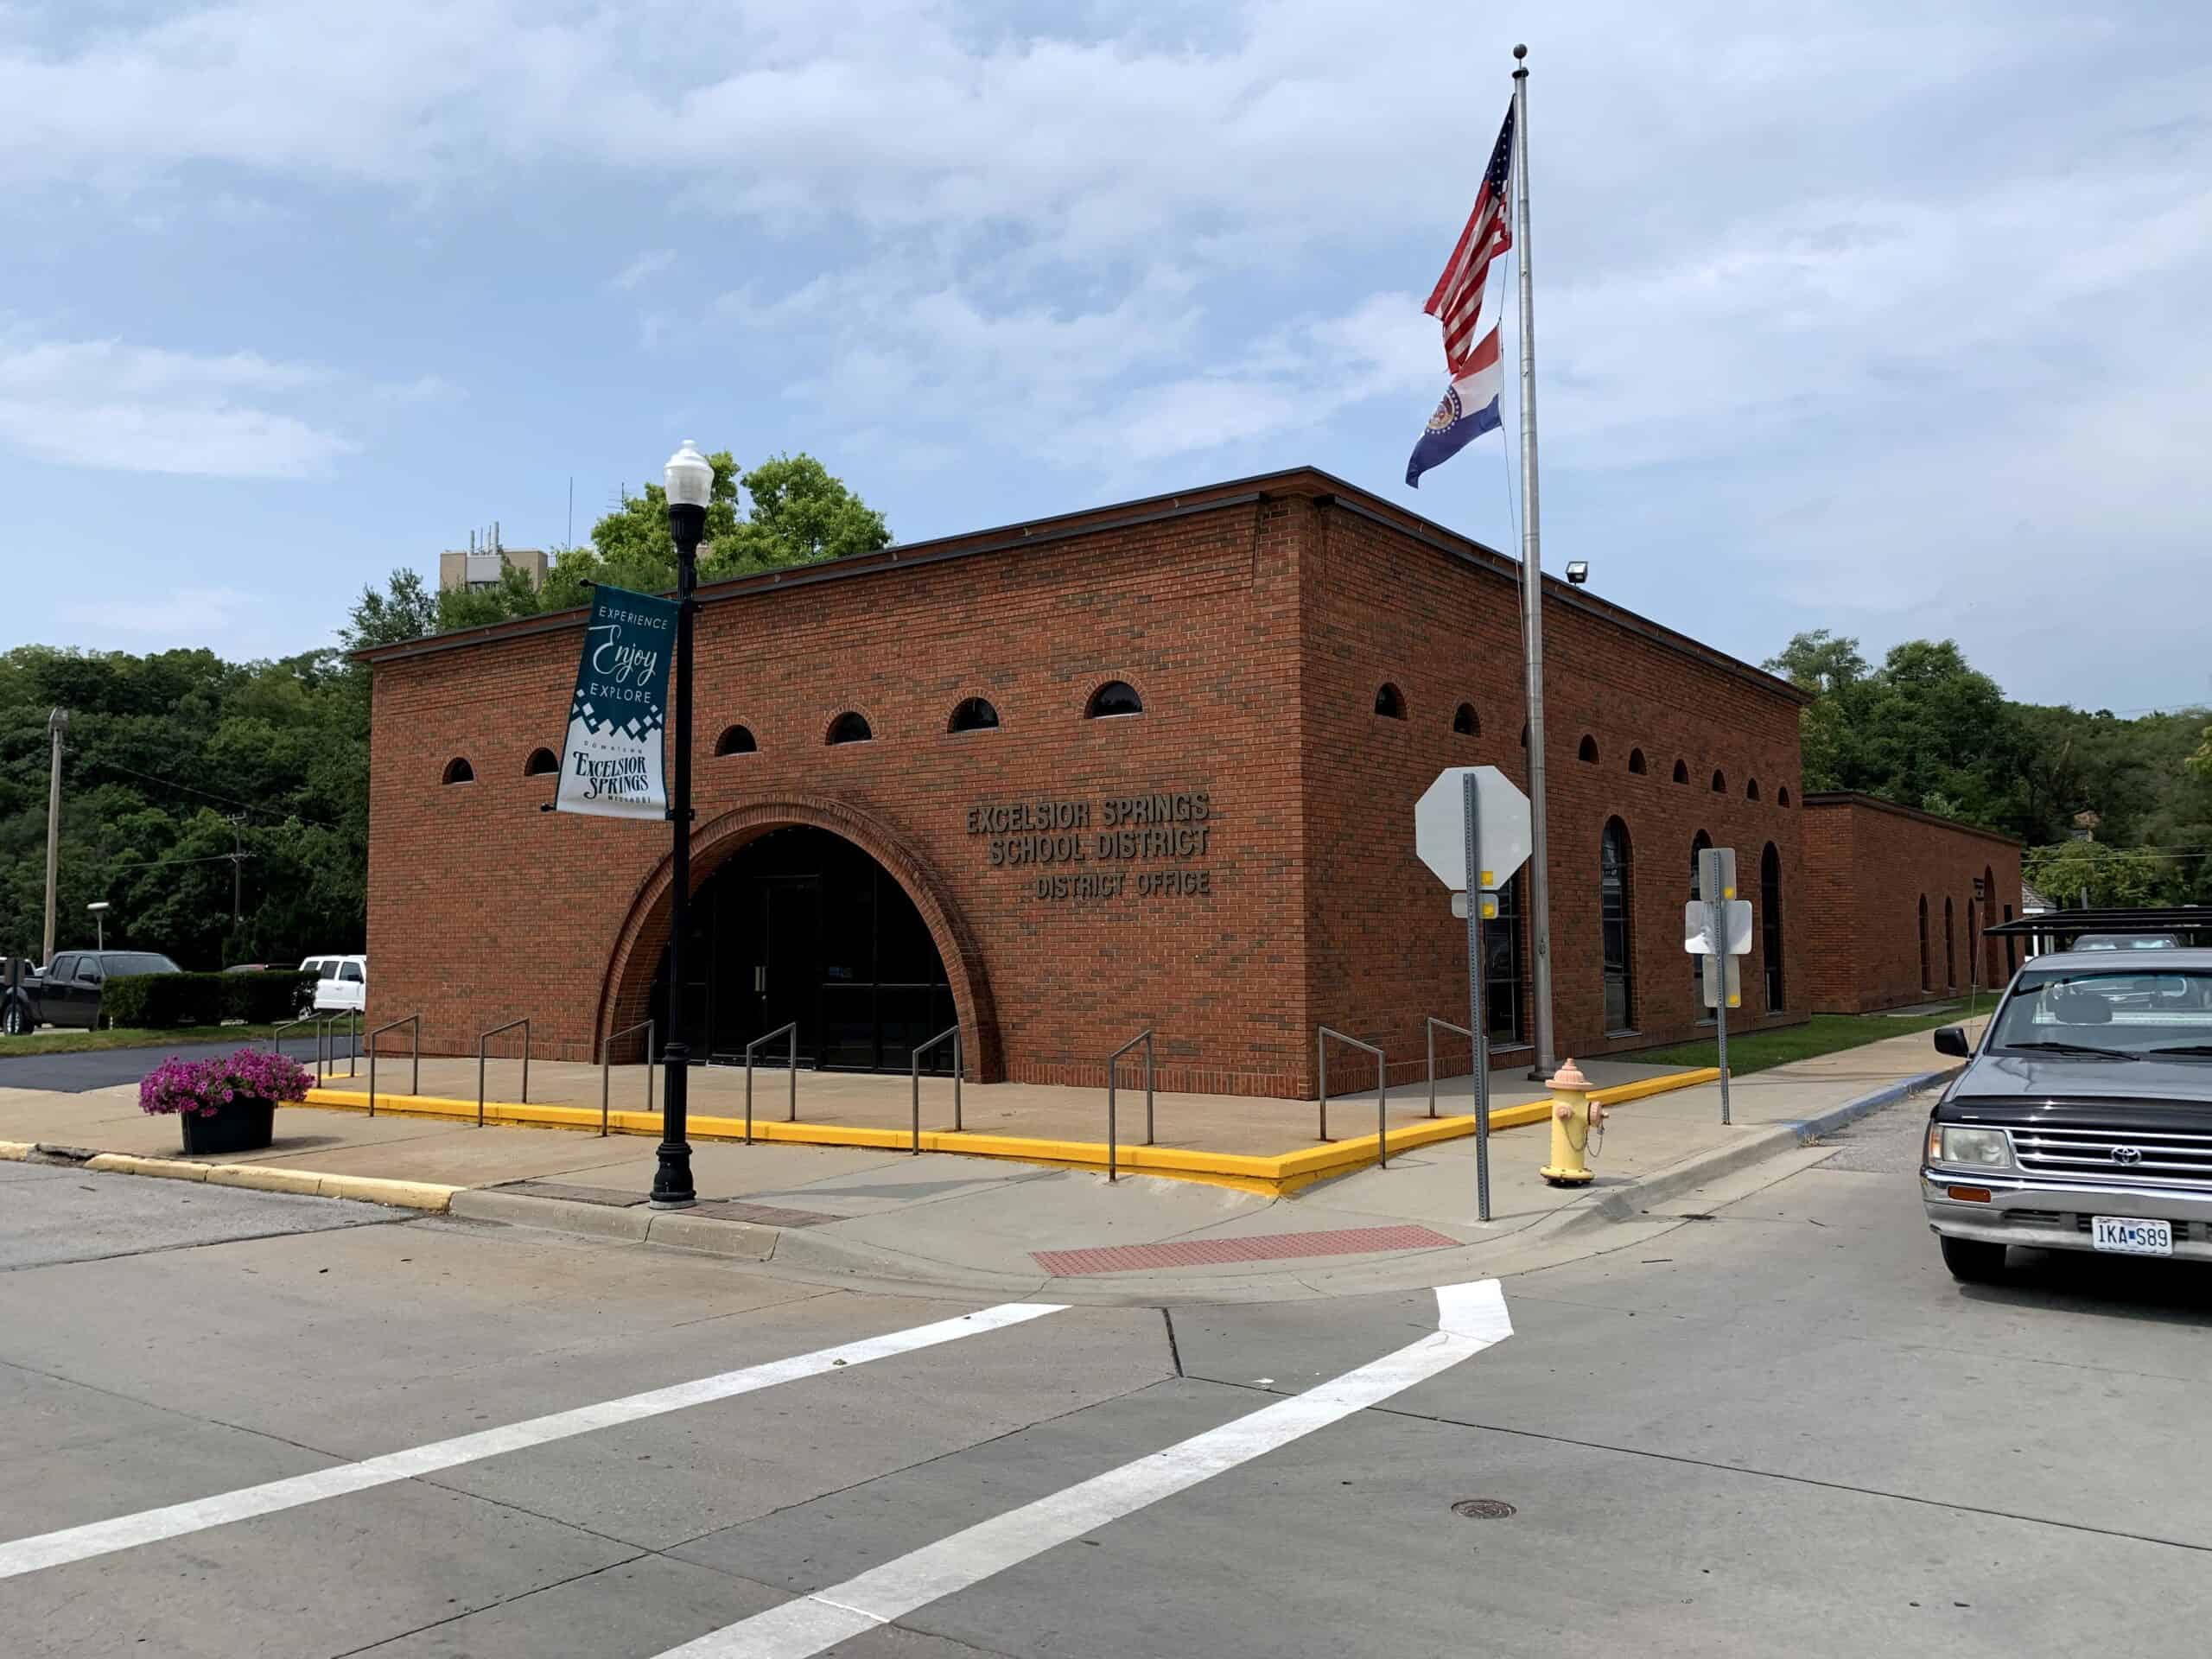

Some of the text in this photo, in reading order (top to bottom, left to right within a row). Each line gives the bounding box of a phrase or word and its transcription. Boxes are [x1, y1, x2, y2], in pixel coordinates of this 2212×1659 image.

[599, 606, 669, 631] EXPERIENCE
[588, 624, 657, 687] Enjoy
[590, 683, 652, 704] EXPLORE
[583, 774, 649, 800] SPRINGS
[966, 791, 1210, 834] EXCELSIOR SPRINGS
[988, 826, 1210, 865] SCHOOL DISTRICT
[1037, 870, 1211, 899] DISTRICT OFFICE
